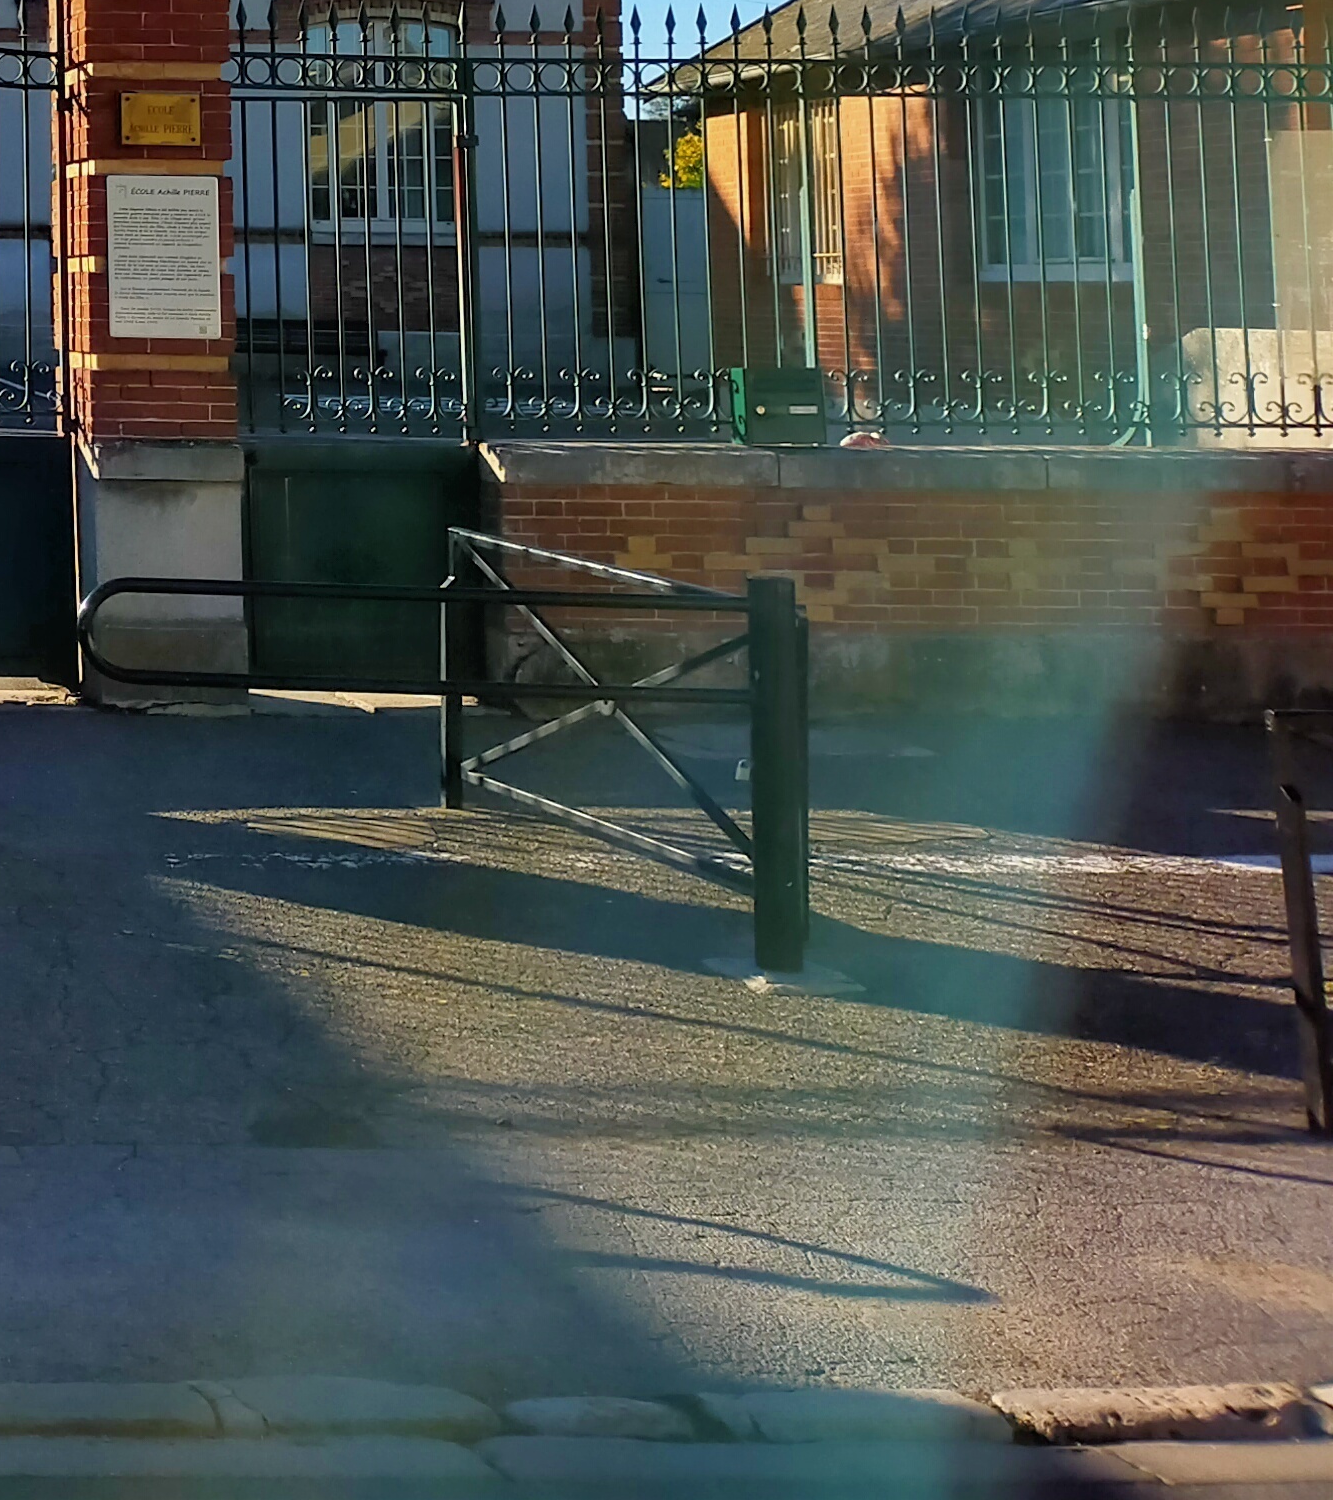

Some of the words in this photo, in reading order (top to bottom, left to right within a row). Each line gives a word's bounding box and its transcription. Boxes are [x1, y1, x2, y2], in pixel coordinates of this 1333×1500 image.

[147, 105, 175, 115] ECOLE
[129, 123, 159, 134] ACHILLE
[163, 124, 194, 134] PIERRE
[130, 186, 155, 195] ÉCOLE
[157, 188, 181, 196] Achille
